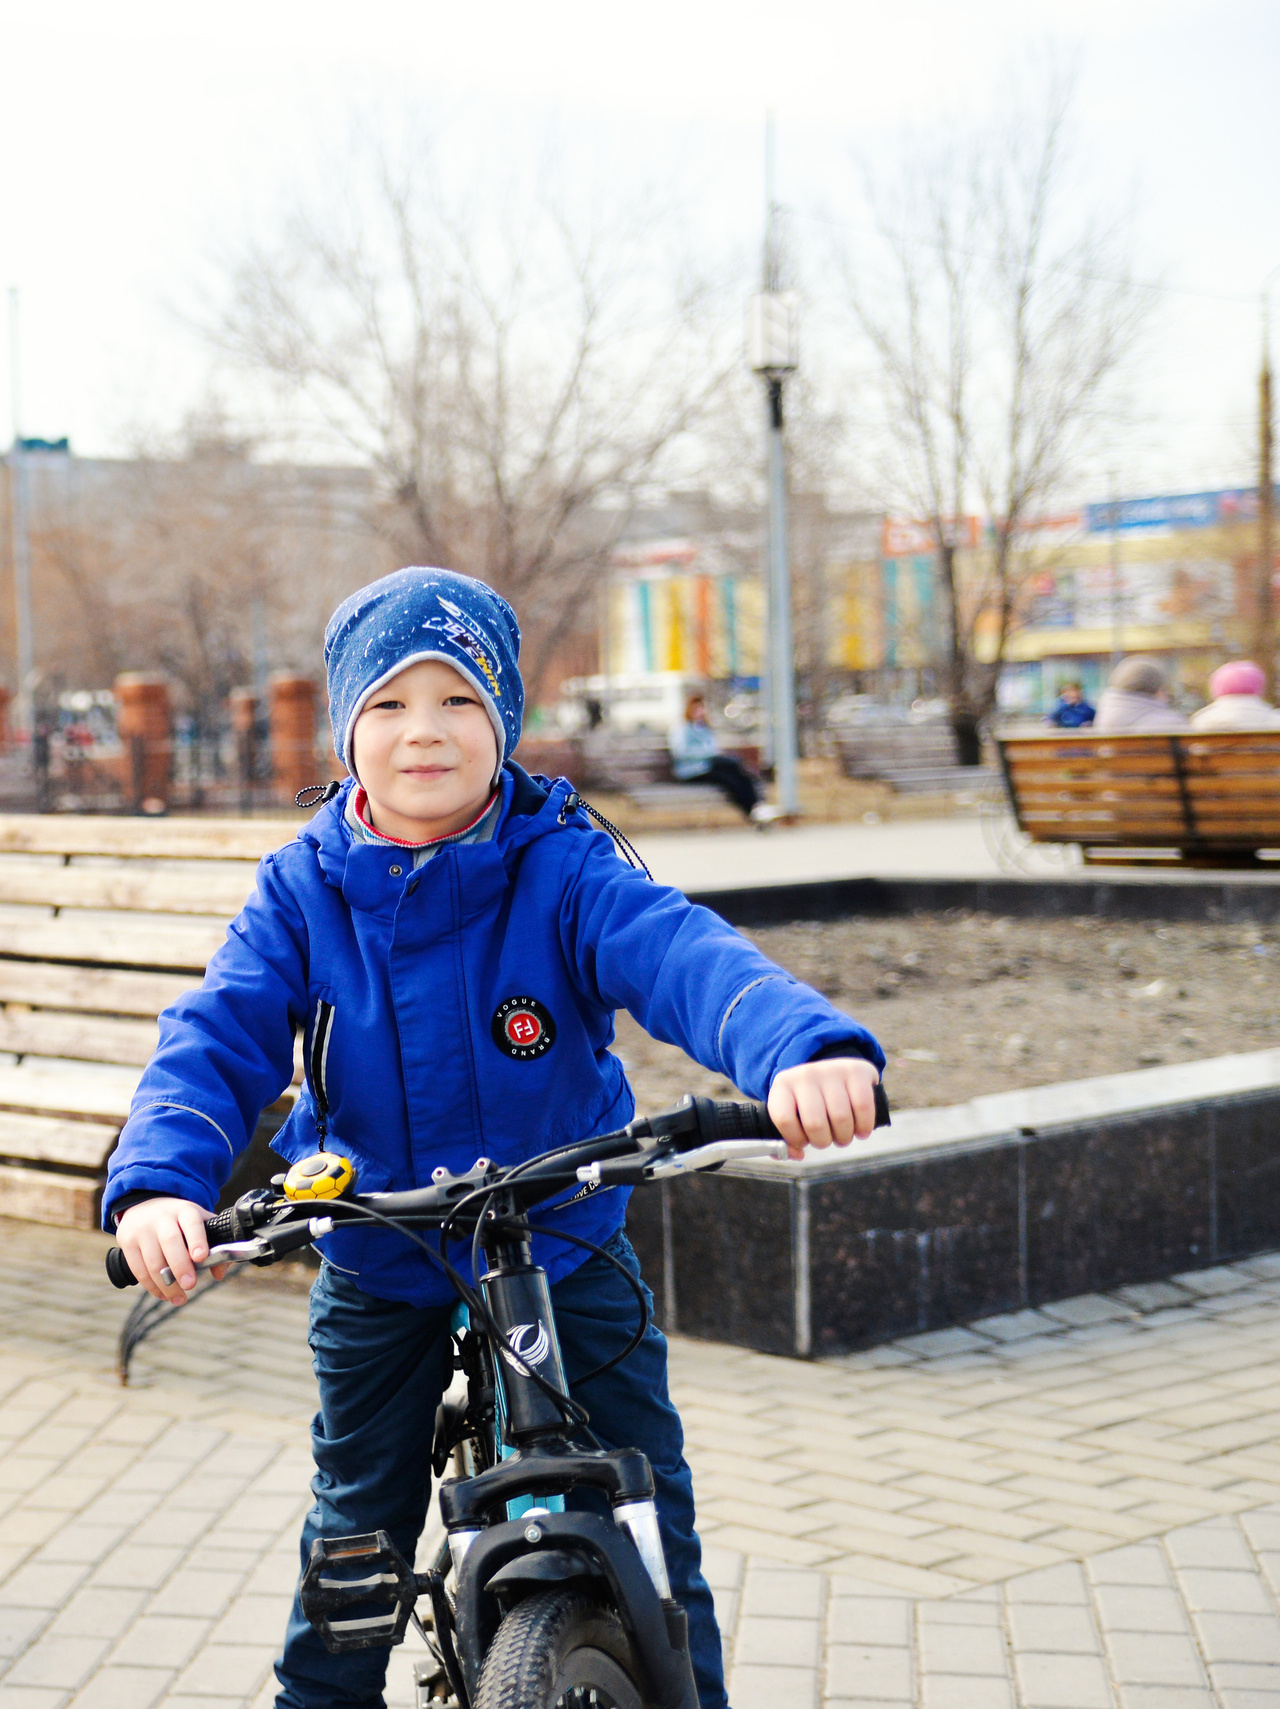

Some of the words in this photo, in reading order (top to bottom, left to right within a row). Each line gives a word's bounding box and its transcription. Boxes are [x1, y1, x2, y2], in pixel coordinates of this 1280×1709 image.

[476, 656, 501, 696] WIN
[496, 998, 536, 1018] VOGUE
[511, 1037, 550, 1057] BRAND
